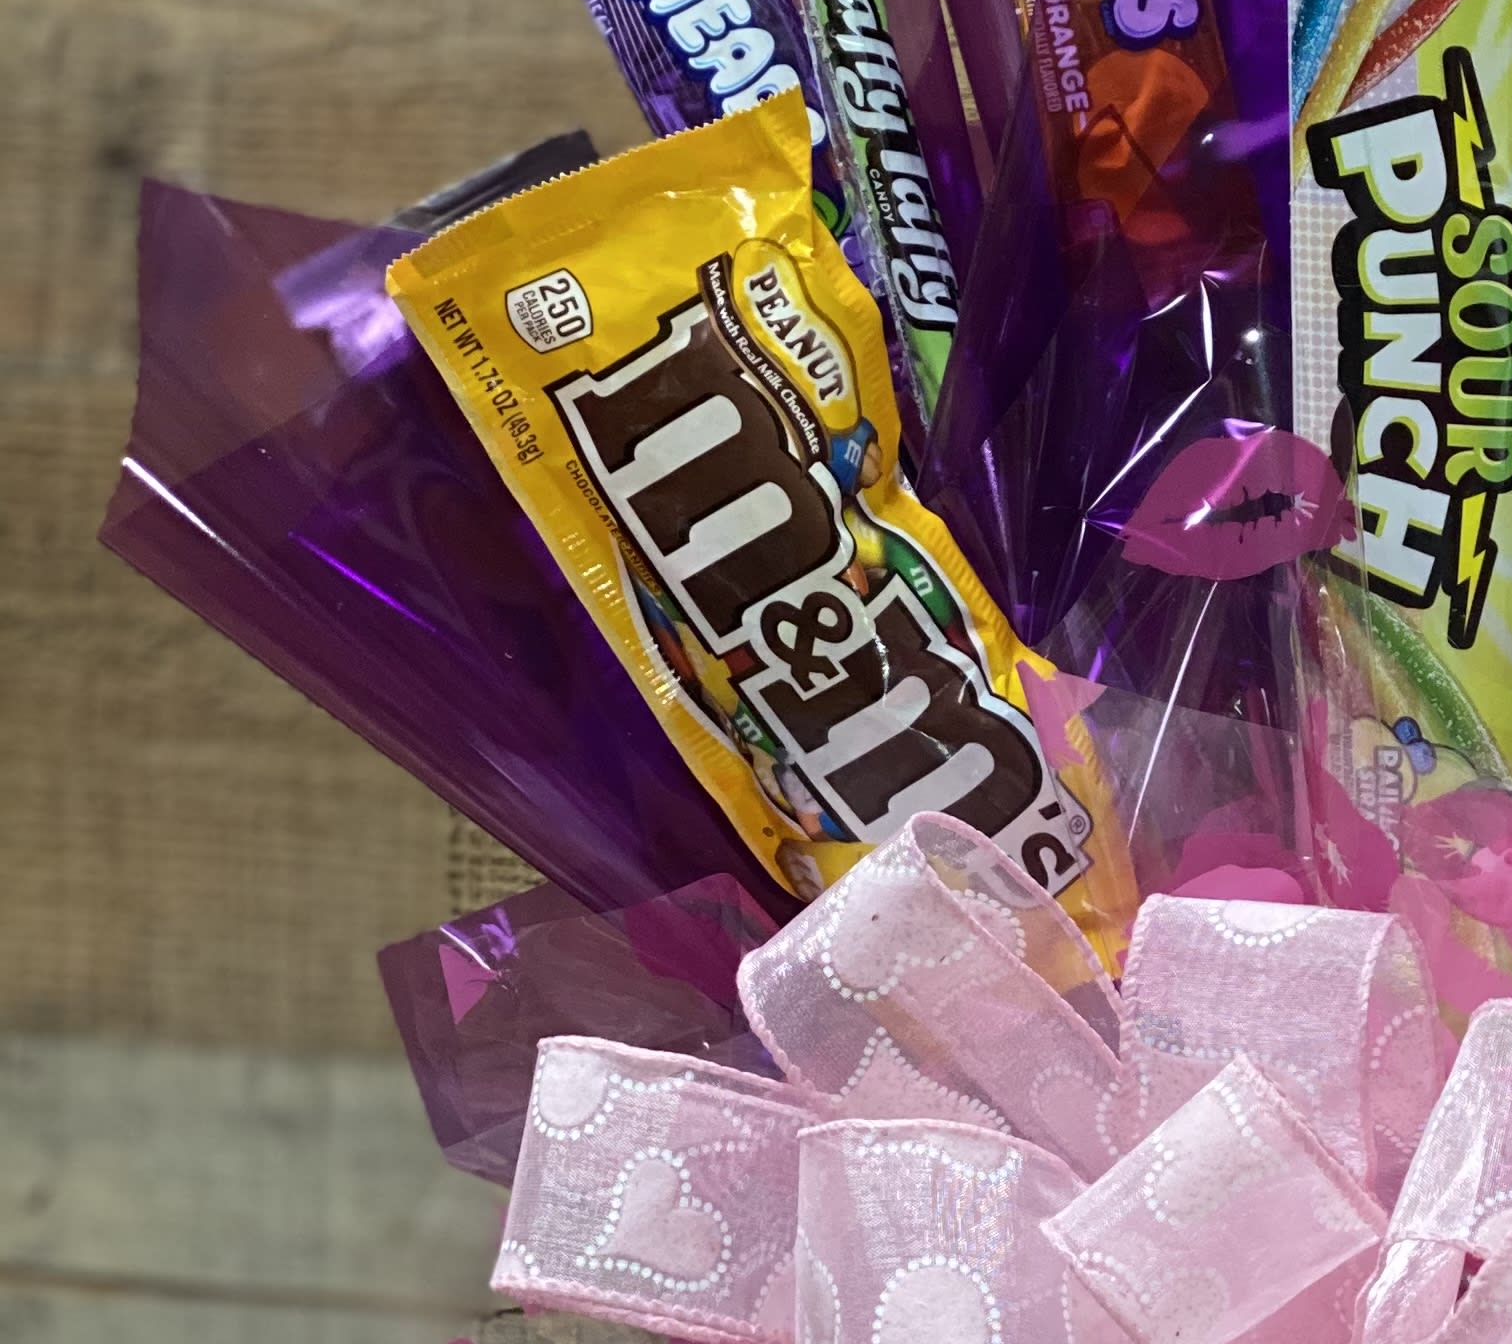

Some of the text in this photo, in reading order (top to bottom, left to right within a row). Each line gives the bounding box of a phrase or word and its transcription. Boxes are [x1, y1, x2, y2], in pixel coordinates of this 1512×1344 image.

[868, 167, 894, 224] CANDY
[513, 300, 541, 343] PER PACK
[519, 288, 559, 345] CALORIES
[534, 274, 591, 340] 250
[747, 266, 846, 400] PEANUT
[432, 296, 550, 467] NET WT 1.74 OZ (49.3g)
[706, 260, 827, 455] Made with Real Milk Chocolate
[1331, 109, 1450, 596] PUNCH
[563, 458, 622, 538] CHOCOLATE
